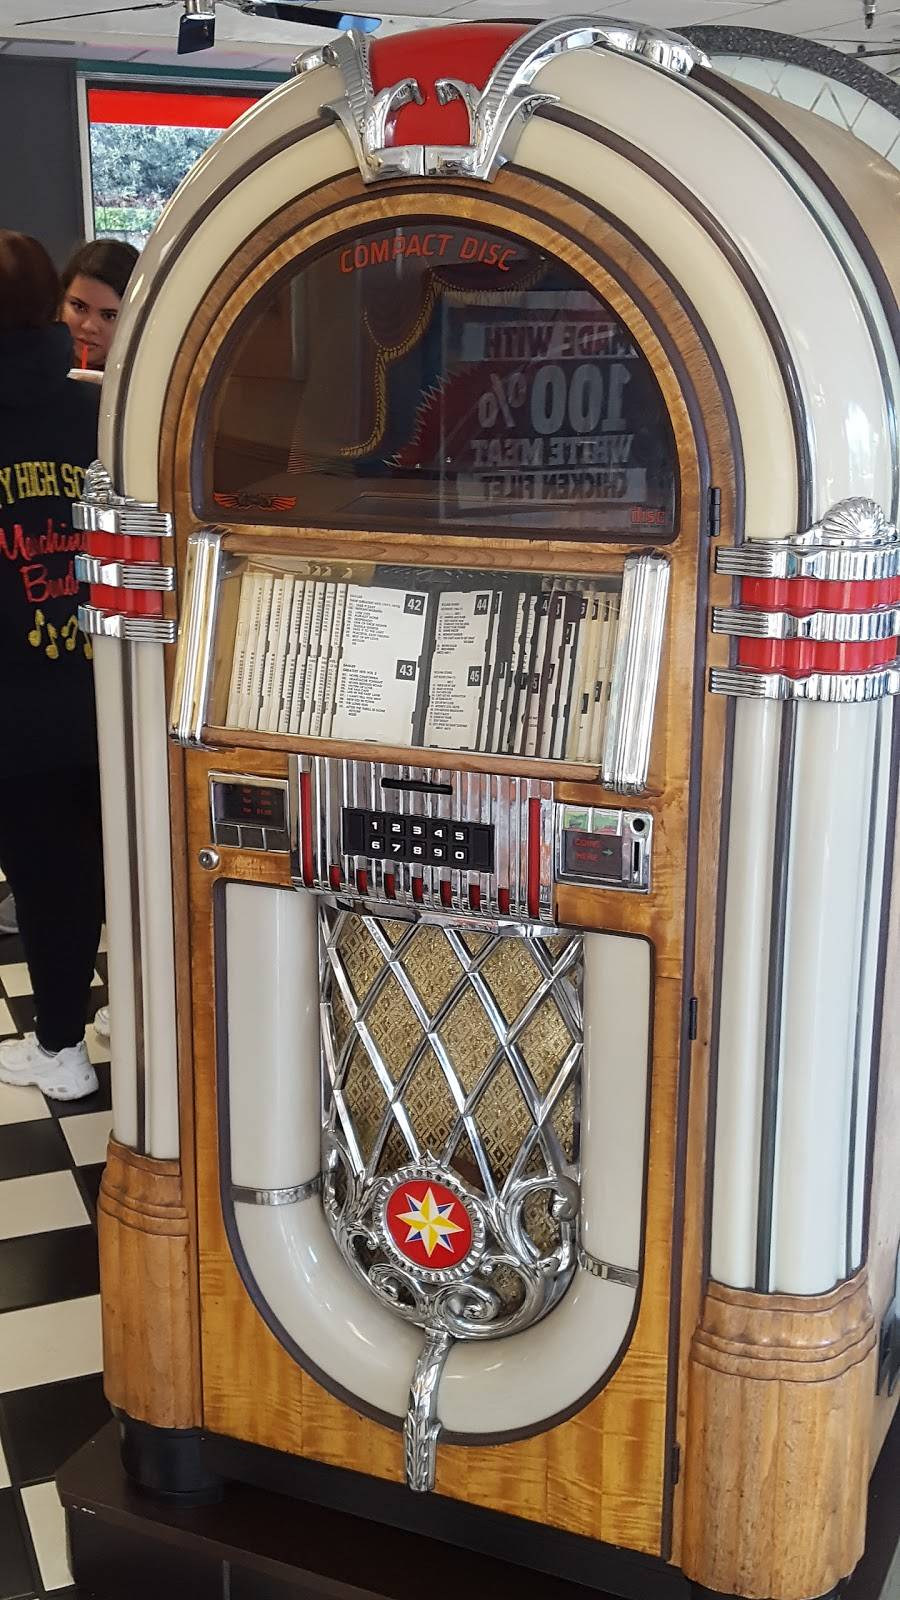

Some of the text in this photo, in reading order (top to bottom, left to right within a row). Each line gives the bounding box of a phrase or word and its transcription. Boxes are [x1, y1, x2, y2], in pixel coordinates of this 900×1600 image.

[339, 233, 517, 273] COMPACT DISC
[0, 466, 15, 505] Y
[14, 461, 61, 499] HIGH
[0, 519, 88, 561] Marchin
[407, 598, 421, 611] 42
[476, 599, 487, 611] 44
[400, 664, 413, 677] 43
[469, 671, 480, 683] 45
[371, 821, 464, 841] 1 2 3 4 5
[371, 841, 465, 860] 6 7 8 9 0
